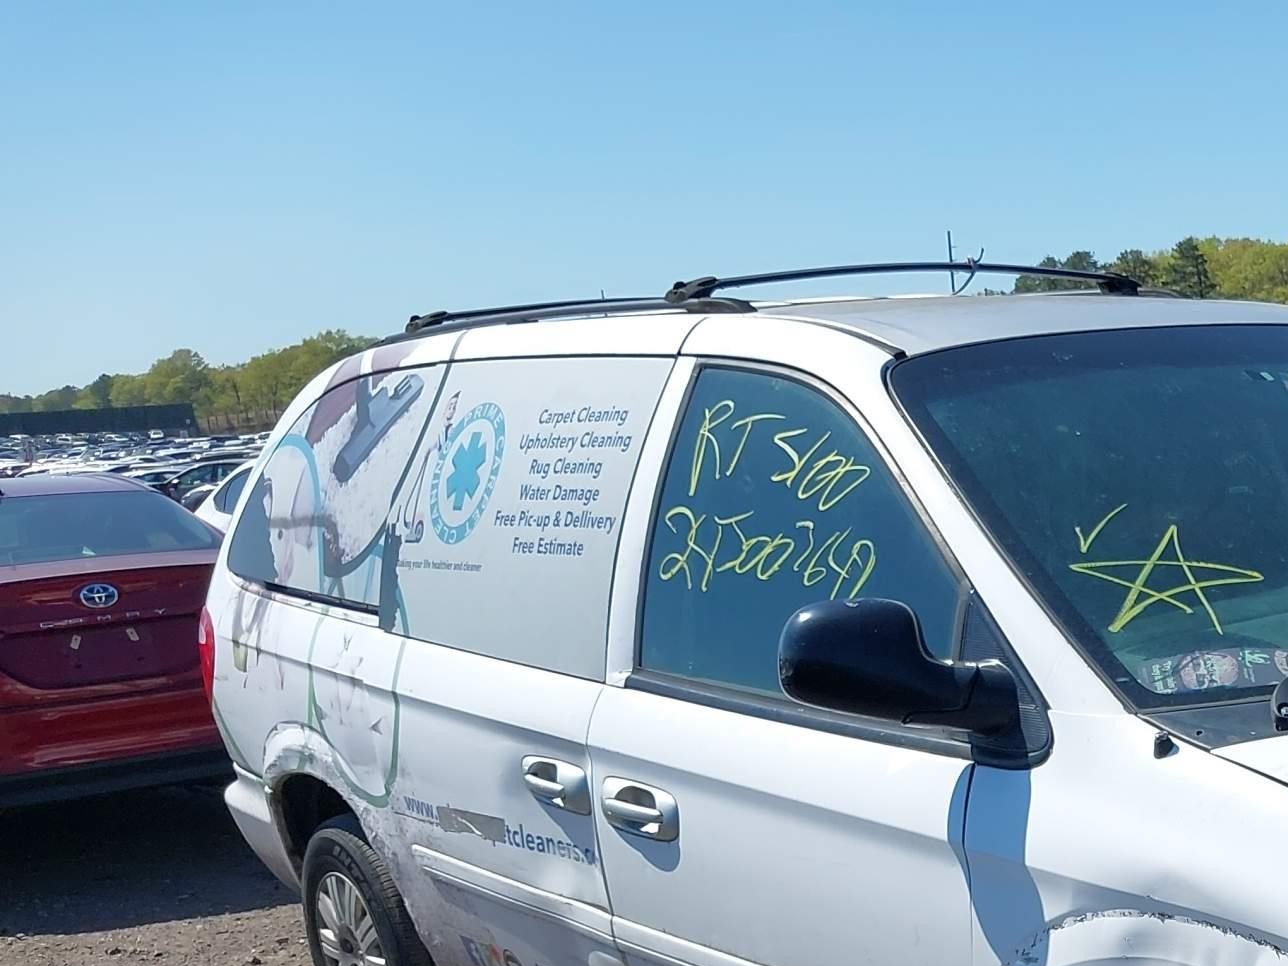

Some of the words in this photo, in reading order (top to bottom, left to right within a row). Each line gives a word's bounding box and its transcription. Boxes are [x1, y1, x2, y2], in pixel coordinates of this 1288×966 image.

[463, 403, 504, 429] PRIME
[539, 408, 576, 428] Carpet
[576, 406, 629, 426] Cleaning
[519, 434, 578, 453] Upholstery
[578, 432, 632, 452] Cleaning
[689, 400, 786, 496] RT
[529, 459, 549, 478] Rug
[552, 458, 603, 479] Cleaning
[519, 485, 551, 501] Water
[552, 485, 600, 505] Damage
[494, 511, 516, 527] Free
[518, 511, 550, 530] Pic-up
[553, 512, 562, 527] &
[564, 512, 616, 535] Dellivery
[512, 537, 535, 554] Free
[537, 538, 584, 556] Estimate
